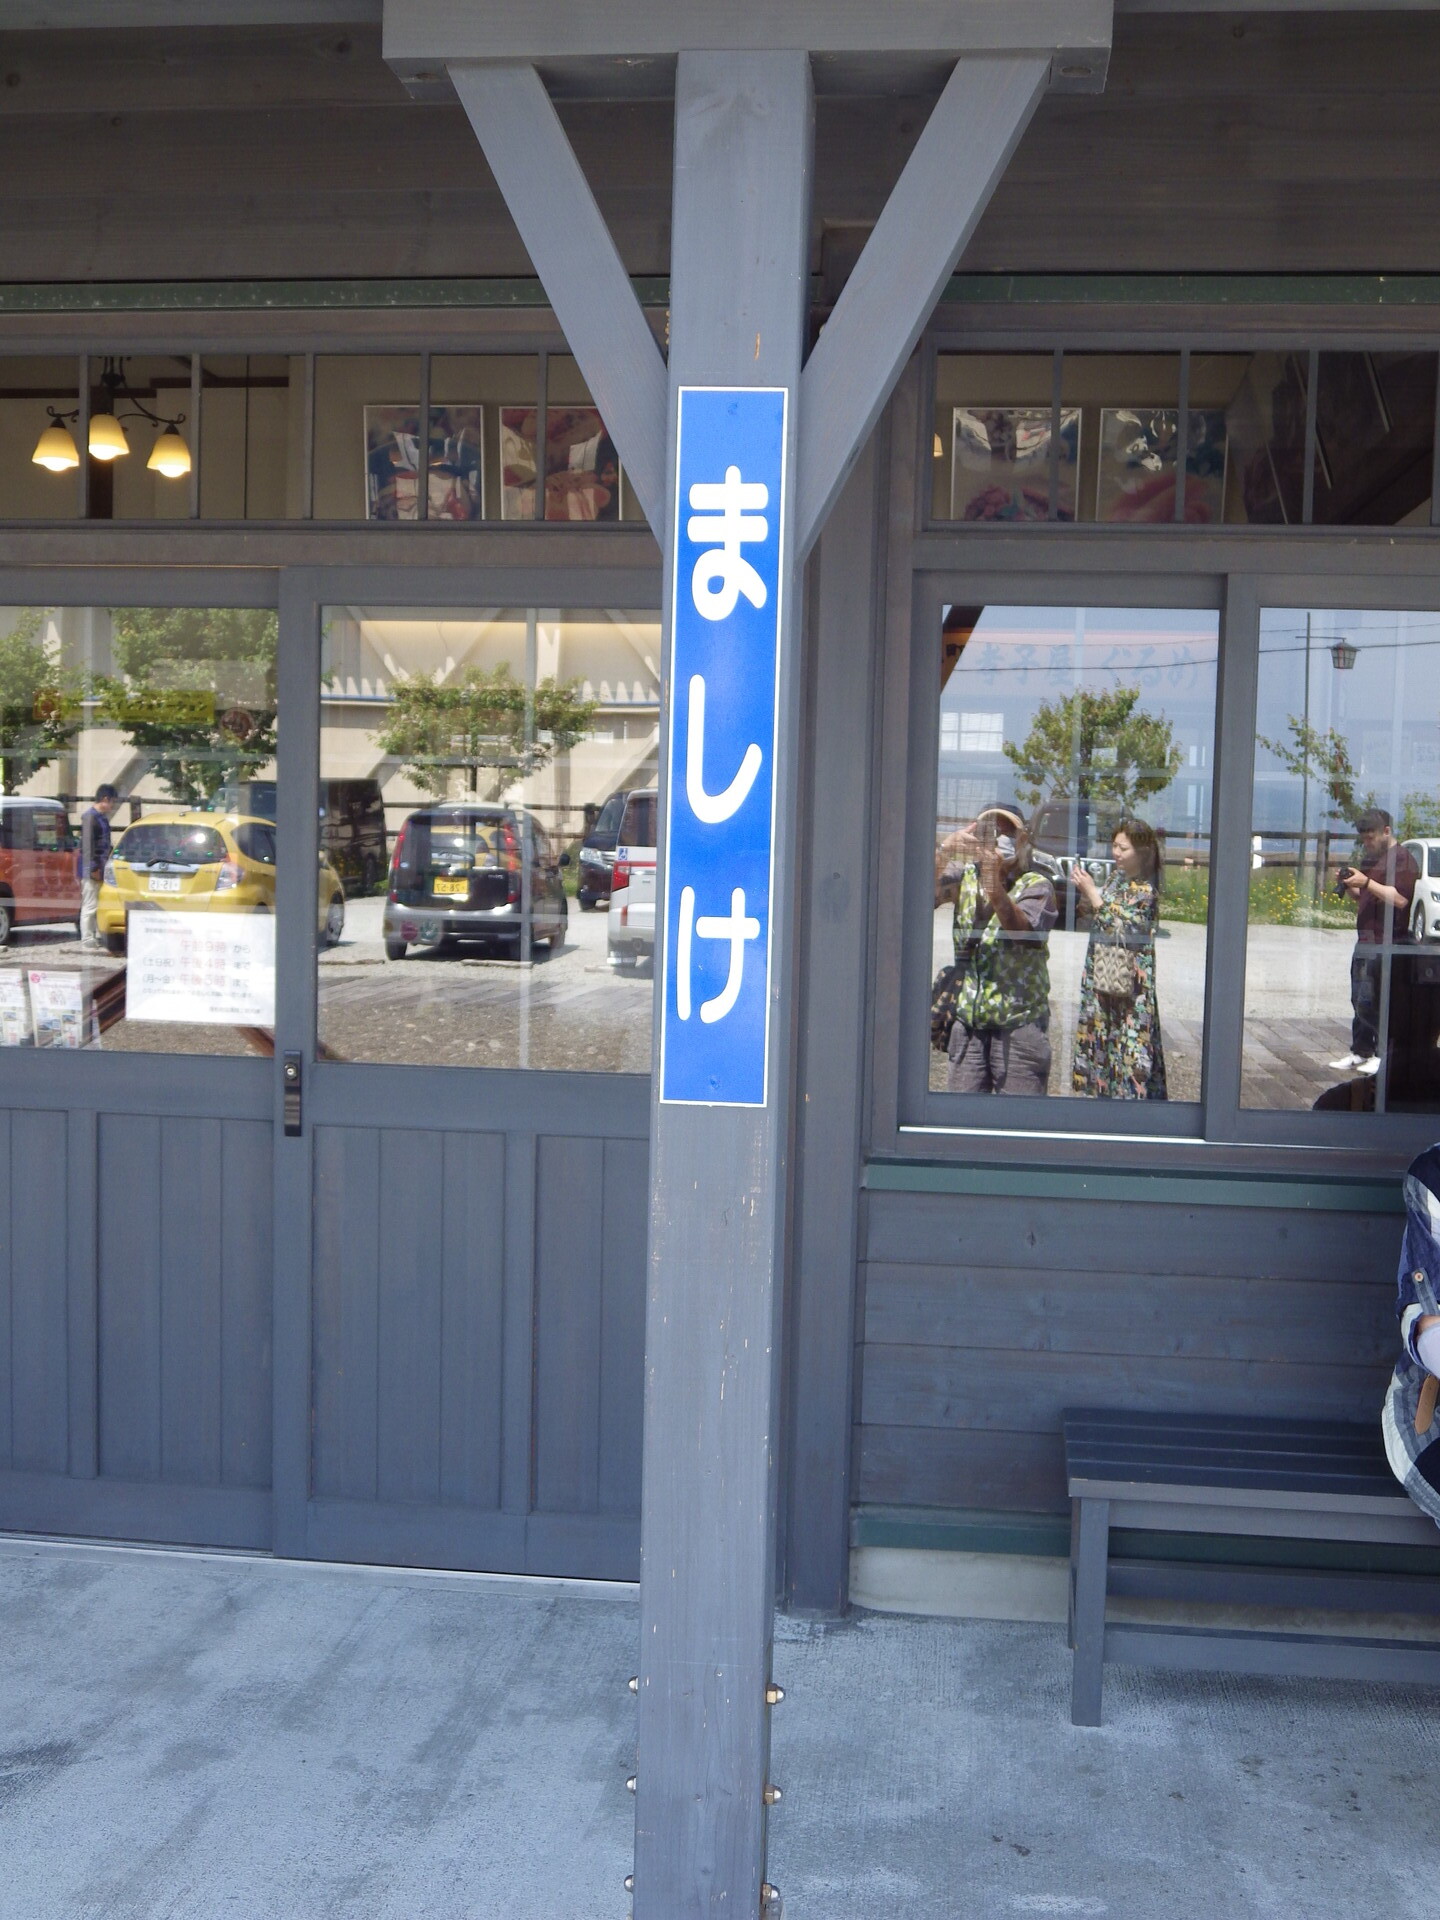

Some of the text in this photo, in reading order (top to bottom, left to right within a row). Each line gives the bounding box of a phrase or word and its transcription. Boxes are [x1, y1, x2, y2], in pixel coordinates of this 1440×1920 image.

[677, 465, 768, 1023] ましけ
[1101, 645, 1199, 689] ぐるめ
